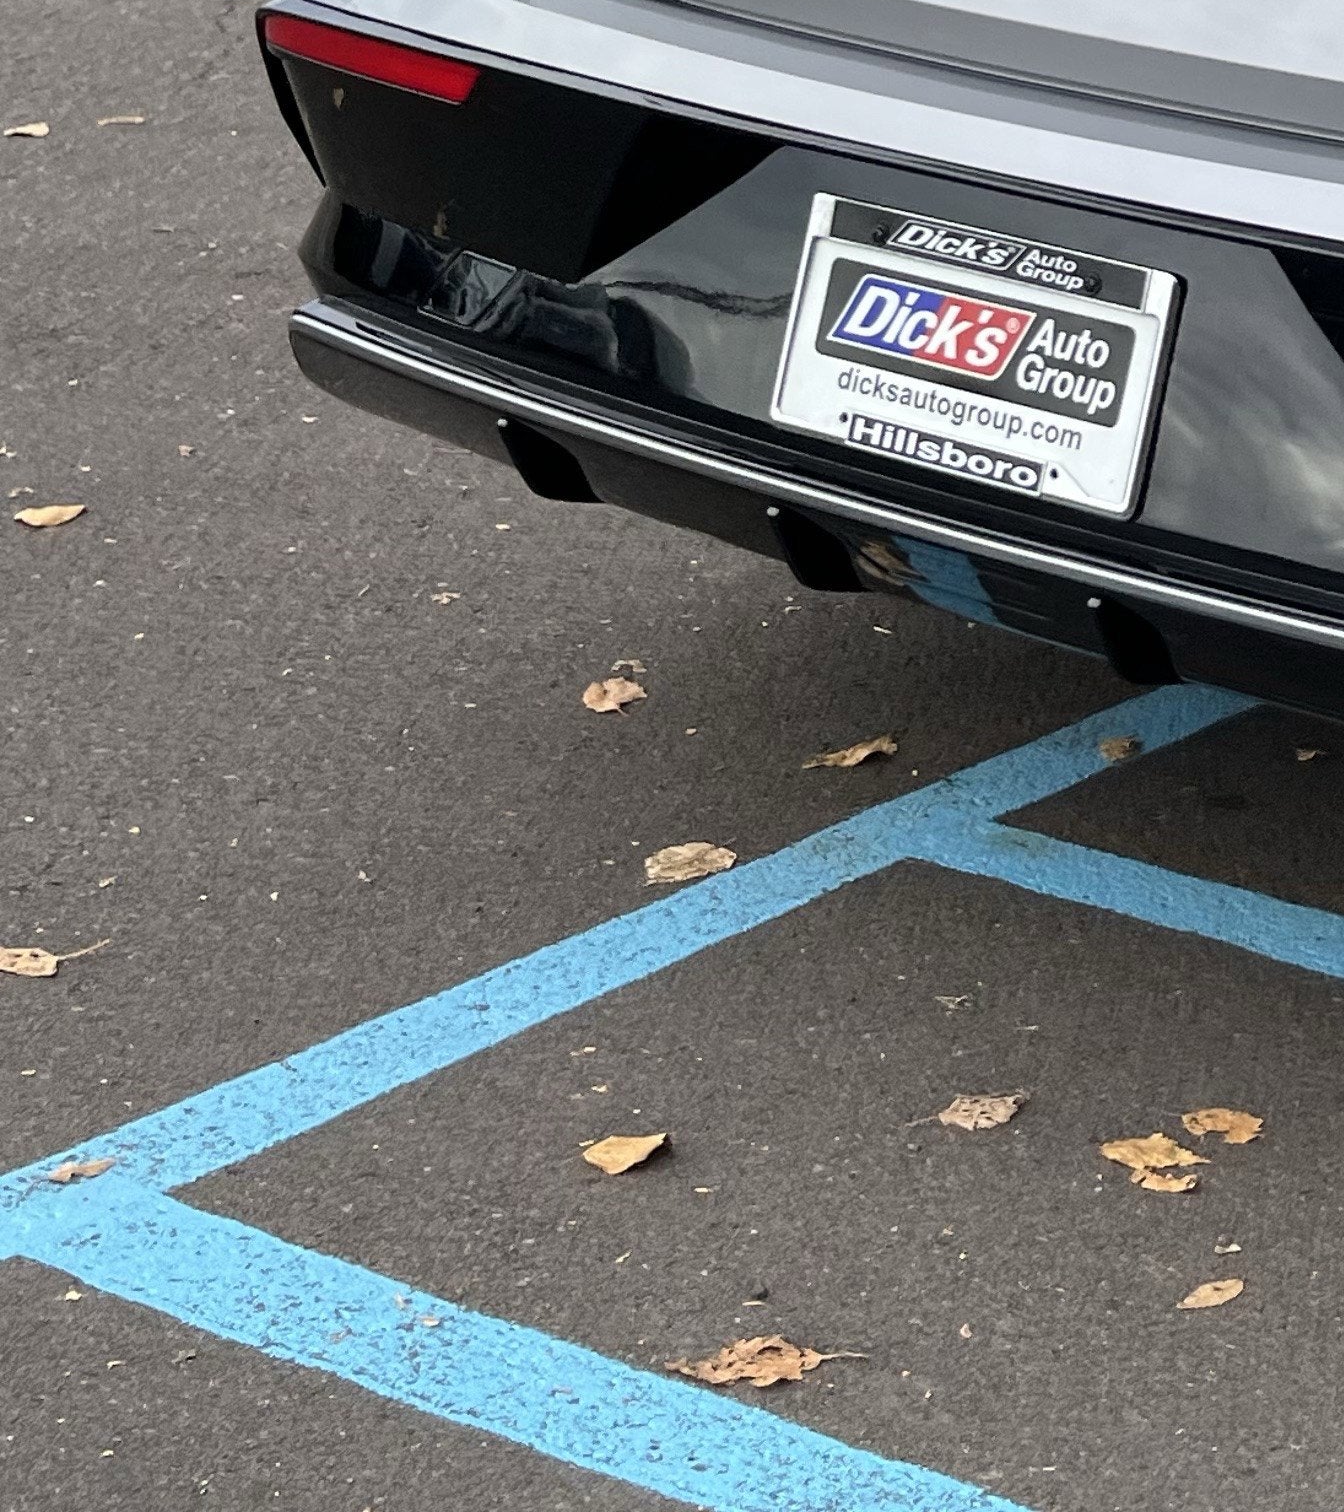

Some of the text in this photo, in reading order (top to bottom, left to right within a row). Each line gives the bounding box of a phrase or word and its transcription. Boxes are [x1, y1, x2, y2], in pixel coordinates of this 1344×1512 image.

[897, 224, 1009, 265] Dick's
[1025, 249, 1078, 273] Auto
[1016, 261, 1084, 291] Group
[843, 285, 1008, 367] Dick's
[1027, 318, 1110, 368] Auto
[837, 367, 1083, 451] dicksautogroup.com
[1016, 355, 1117, 415] Group
[850, 416, 1038, 487] Hillsboro
